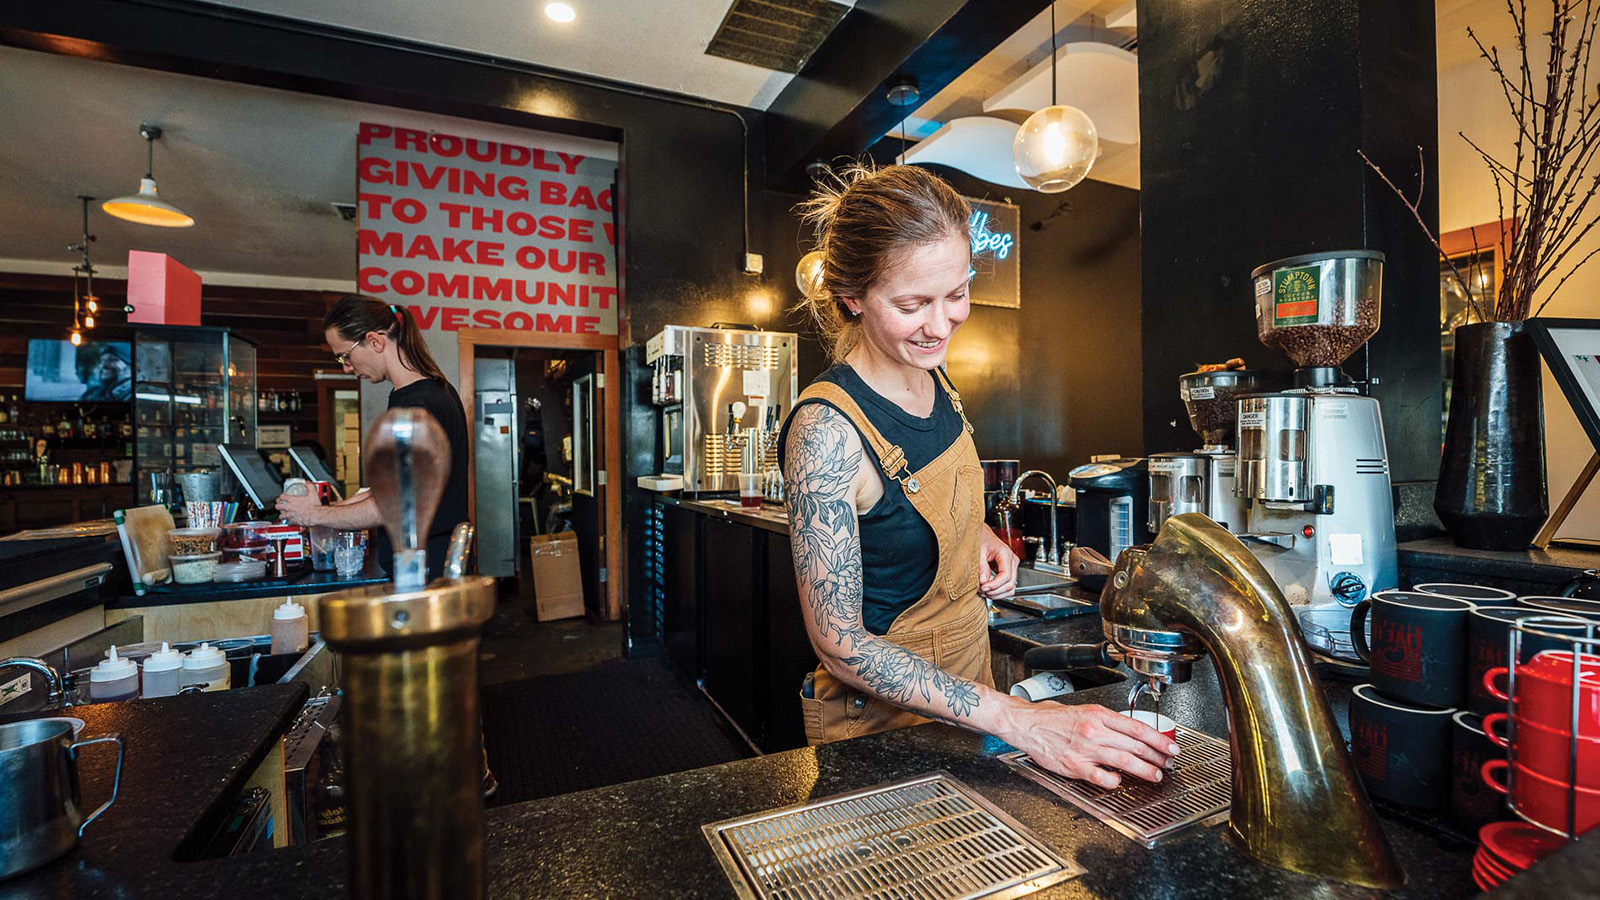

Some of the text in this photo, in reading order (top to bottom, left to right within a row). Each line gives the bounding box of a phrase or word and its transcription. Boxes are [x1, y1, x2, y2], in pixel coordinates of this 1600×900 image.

[359, 121, 585, 175] PROUDLY
[359, 157, 614, 213] GIVING BAC
[359, 193, 427, 224] TO
[438, 202, 594, 243] THOSE
[359, 229, 606, 276] MAKE OUR
[359, 267, 618, 310] COMMUNIT
[1278, 271, 1316, 294] STUMPTOWN
[406, 304, 601, 335] WESOME
